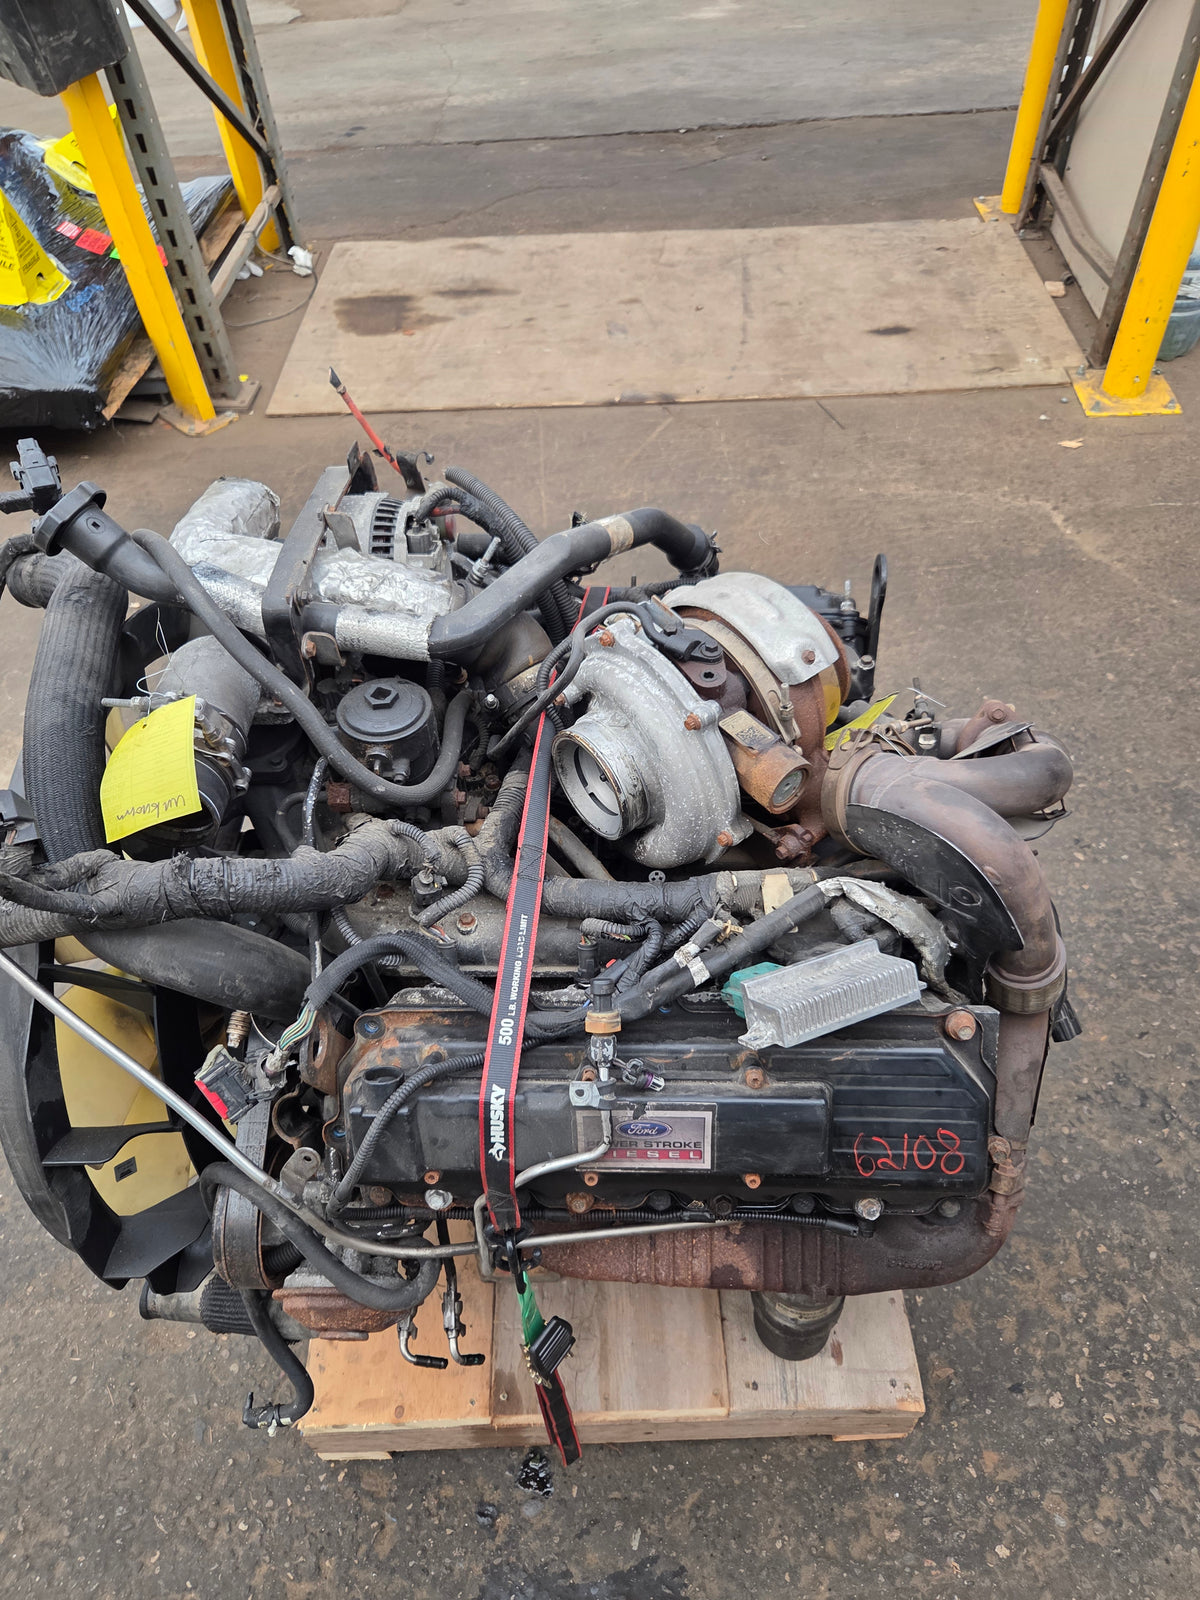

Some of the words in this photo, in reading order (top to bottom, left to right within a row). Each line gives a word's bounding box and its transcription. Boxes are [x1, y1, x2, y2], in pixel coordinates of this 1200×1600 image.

[519, 913, 529, 935] LIMIT
[516, 935, 525, 958] LOAD
[510, 960, 522, 1000] WORKING
[507, 1002, 517, 1016] LB.
[498, 1018, 515, 1046] 500
[490, 1083, 506, 1143] HUSKY
[627, 1123, 658, 1135] Ford
[612, 1149, 701, 1159] IESEL
[643, 1140, 702, 1149] STROKE
[853, 1127, 965, 1177] 62108
